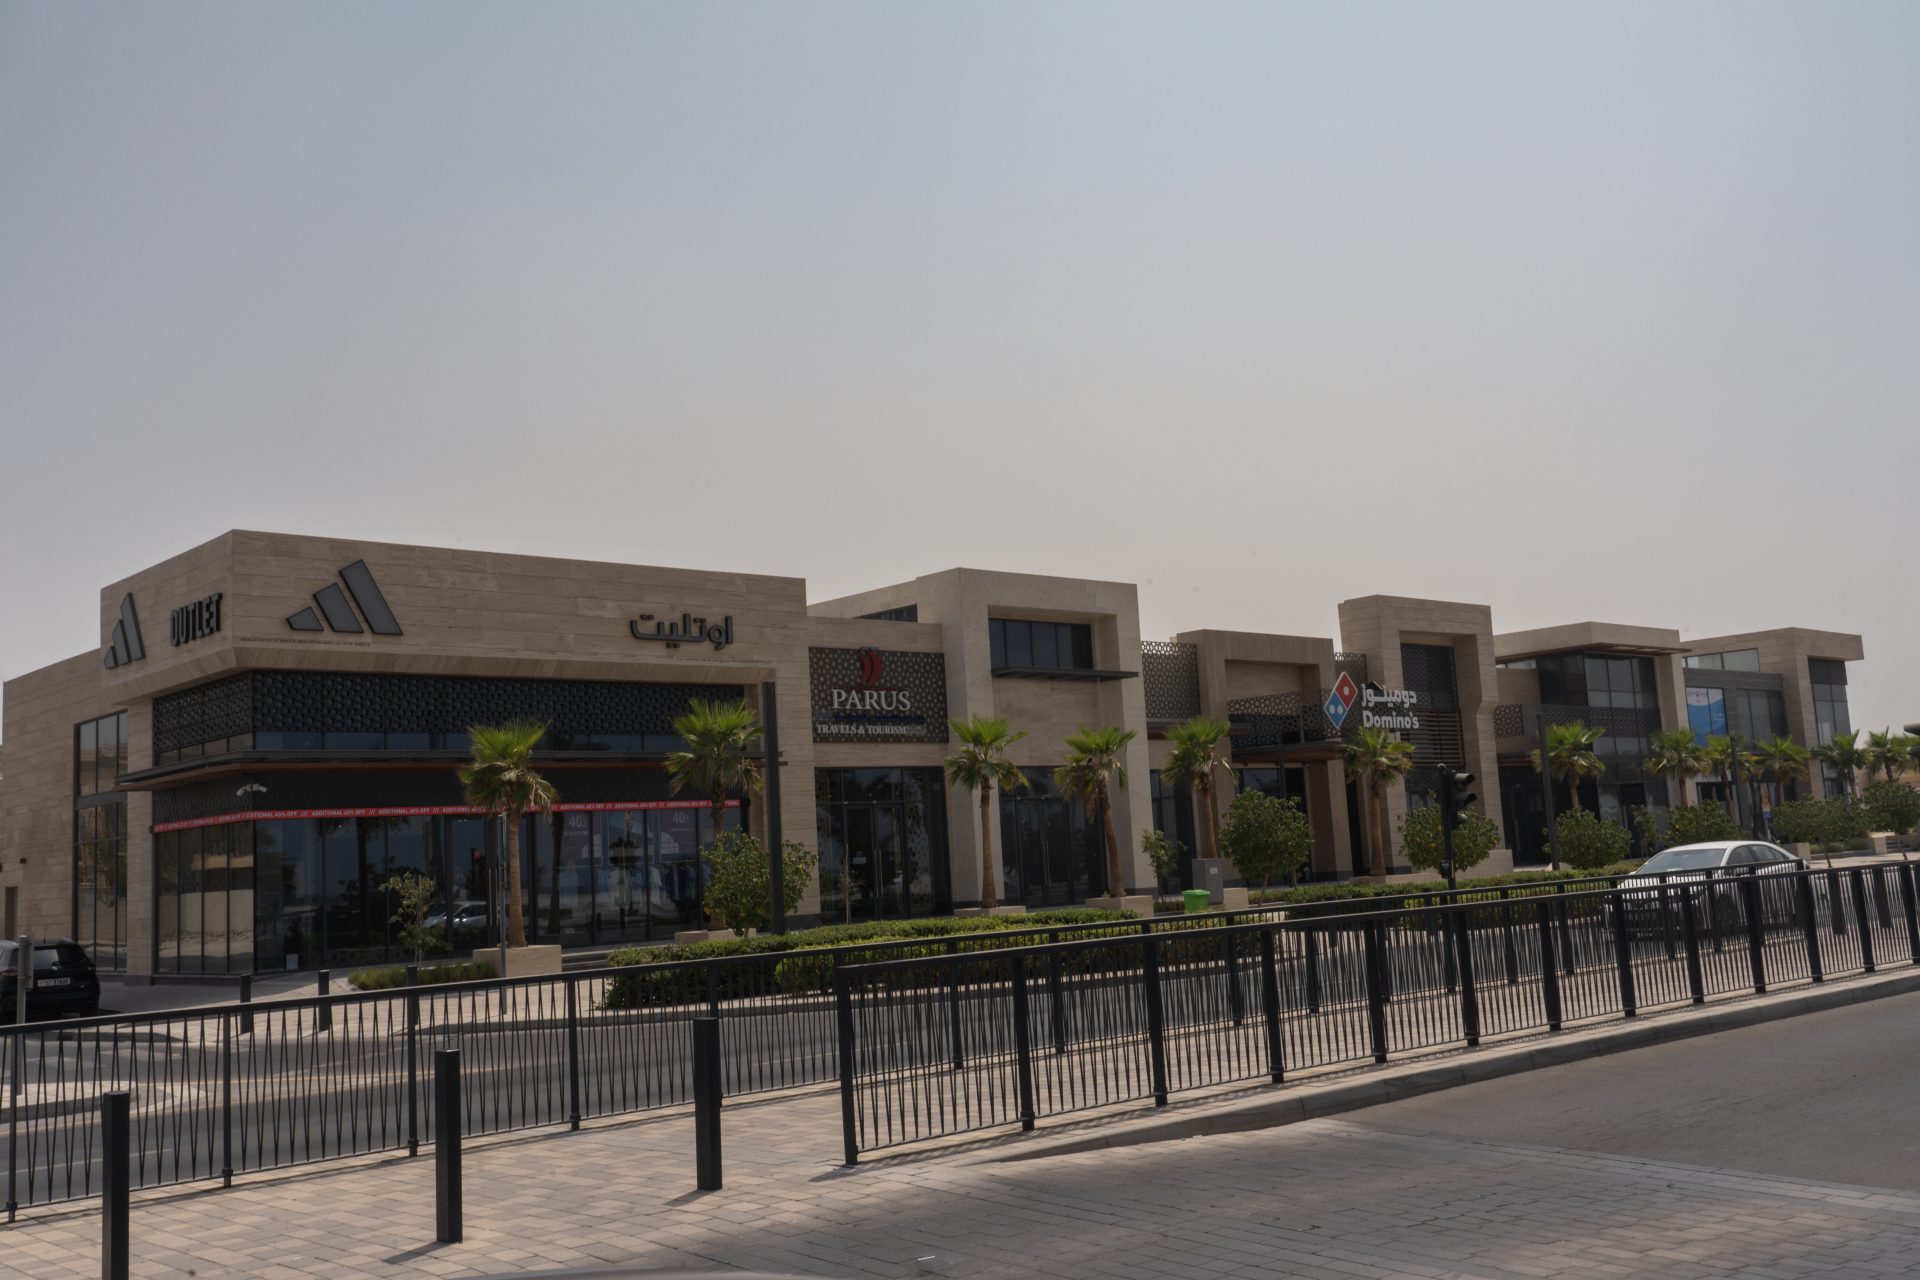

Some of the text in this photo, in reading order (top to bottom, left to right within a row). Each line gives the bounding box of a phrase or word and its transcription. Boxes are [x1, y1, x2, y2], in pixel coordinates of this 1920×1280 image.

[171, 592, 223, 647] OUTLET
[629, 613, 734, 651] اوتليت
[831, 689, 911, 711] PARUS
[816, 723, 857, 734] TRAVELS
[858, 725, 866, 734] &
[866, 724, 907, 735] TOURISM
[1362, 710, 1420, 729] Domino's
[312, 809, 343, 817] ADDITIONAL
